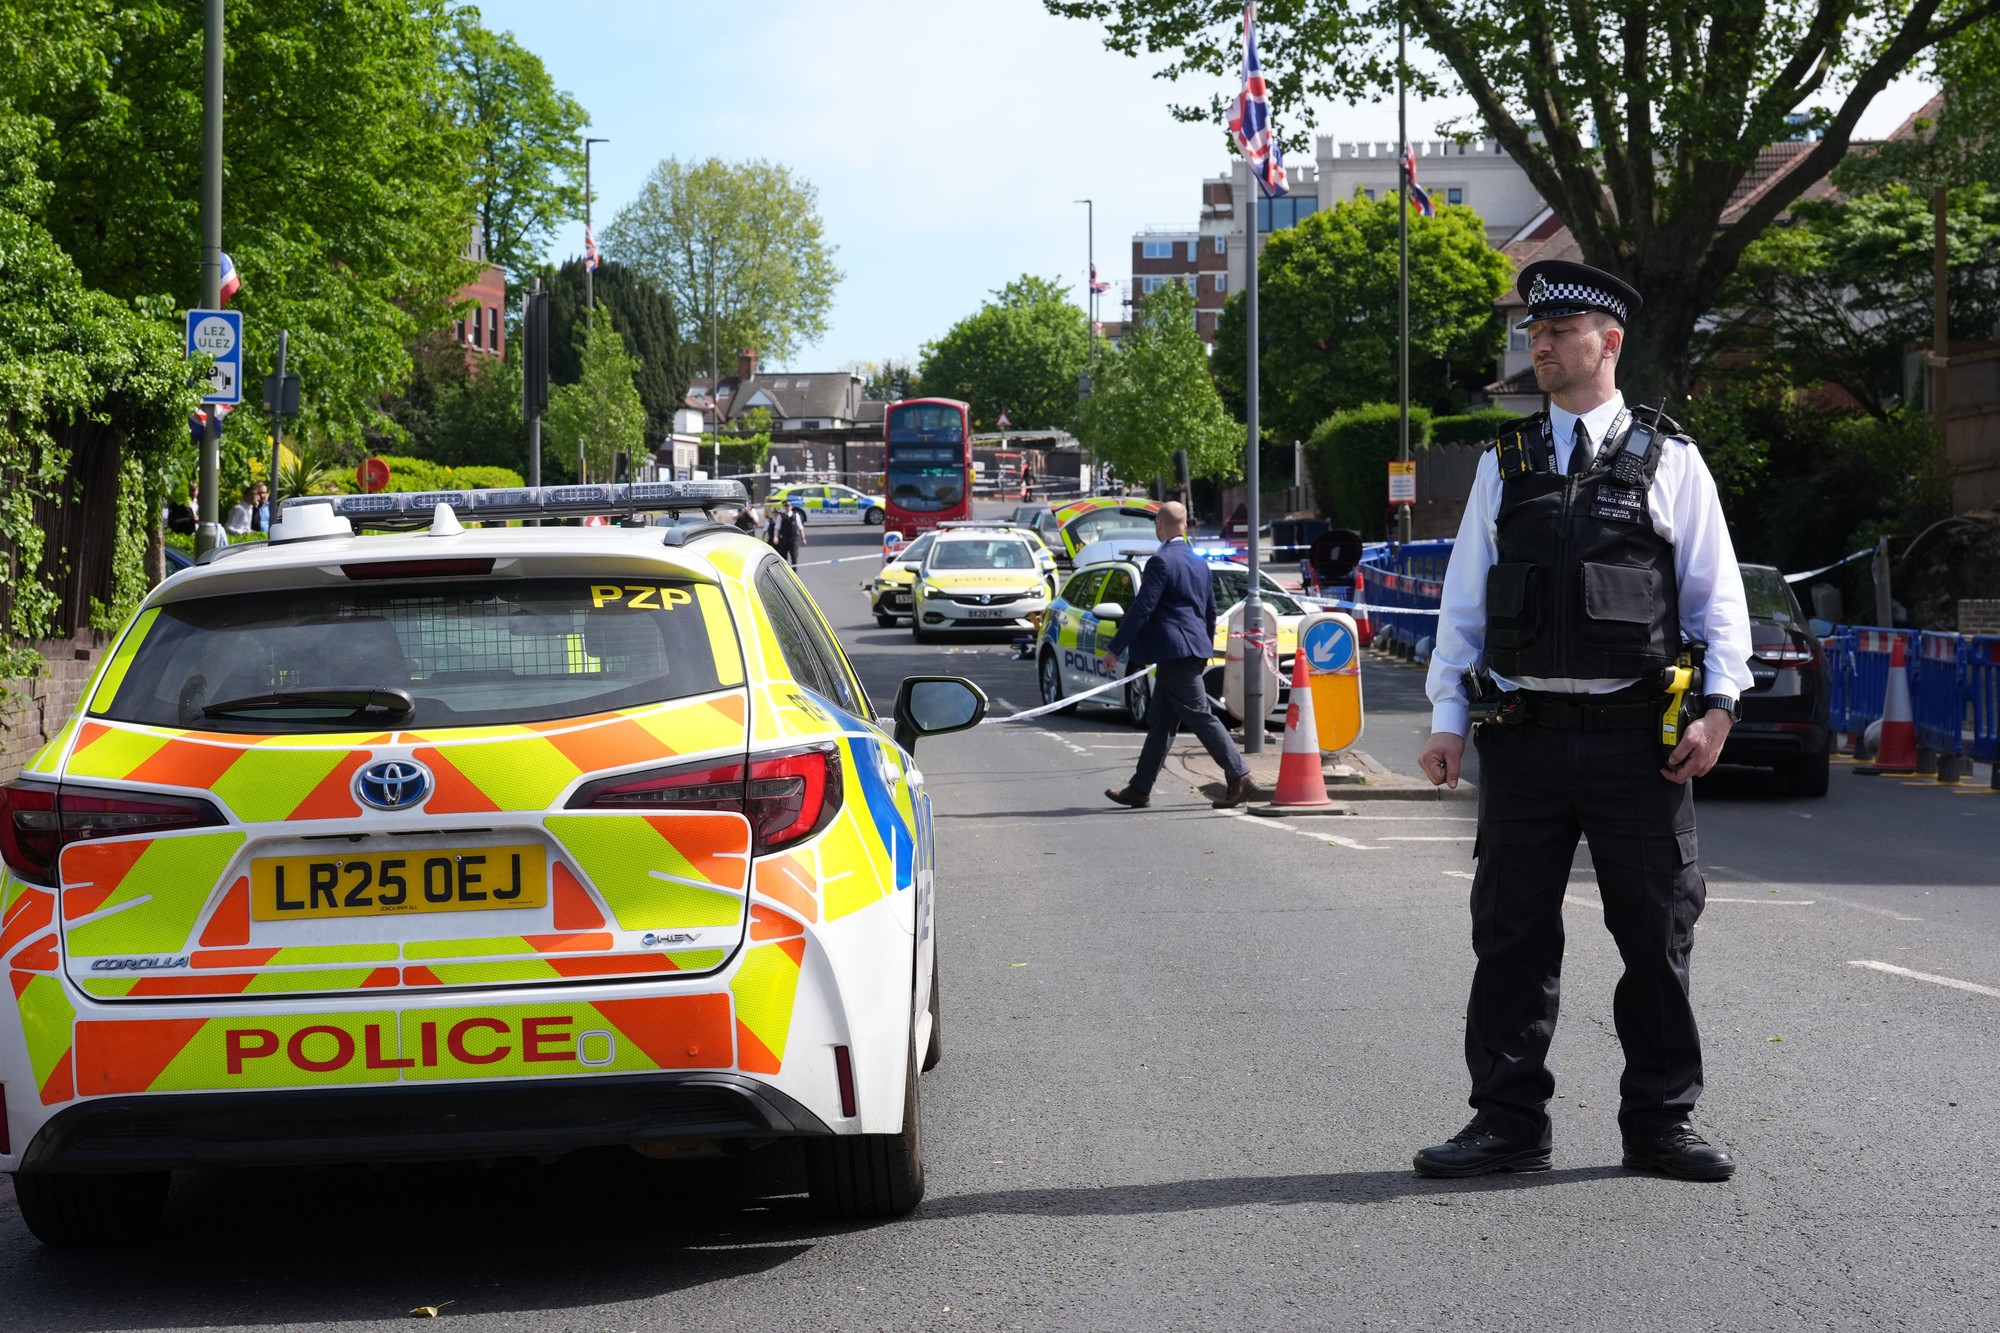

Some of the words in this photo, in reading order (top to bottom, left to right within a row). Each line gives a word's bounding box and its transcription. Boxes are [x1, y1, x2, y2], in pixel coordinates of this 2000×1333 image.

[203, 326, 226, 336] LEZ
[198, 338, 230, 348] ULEZ
[1618, 499, 1641, 508] OFFICER
[590, 585, 692, 611] PZP
[968, 610, 988, 618] BX20
[275, 859, 407, 911] LR25
[423, 853, 522, 903] OEJ
[656, 933, 702, 943] HEV
[91, 956, 190, 970] COROLLA
[225, 1015, 577, 1074] POLICE
